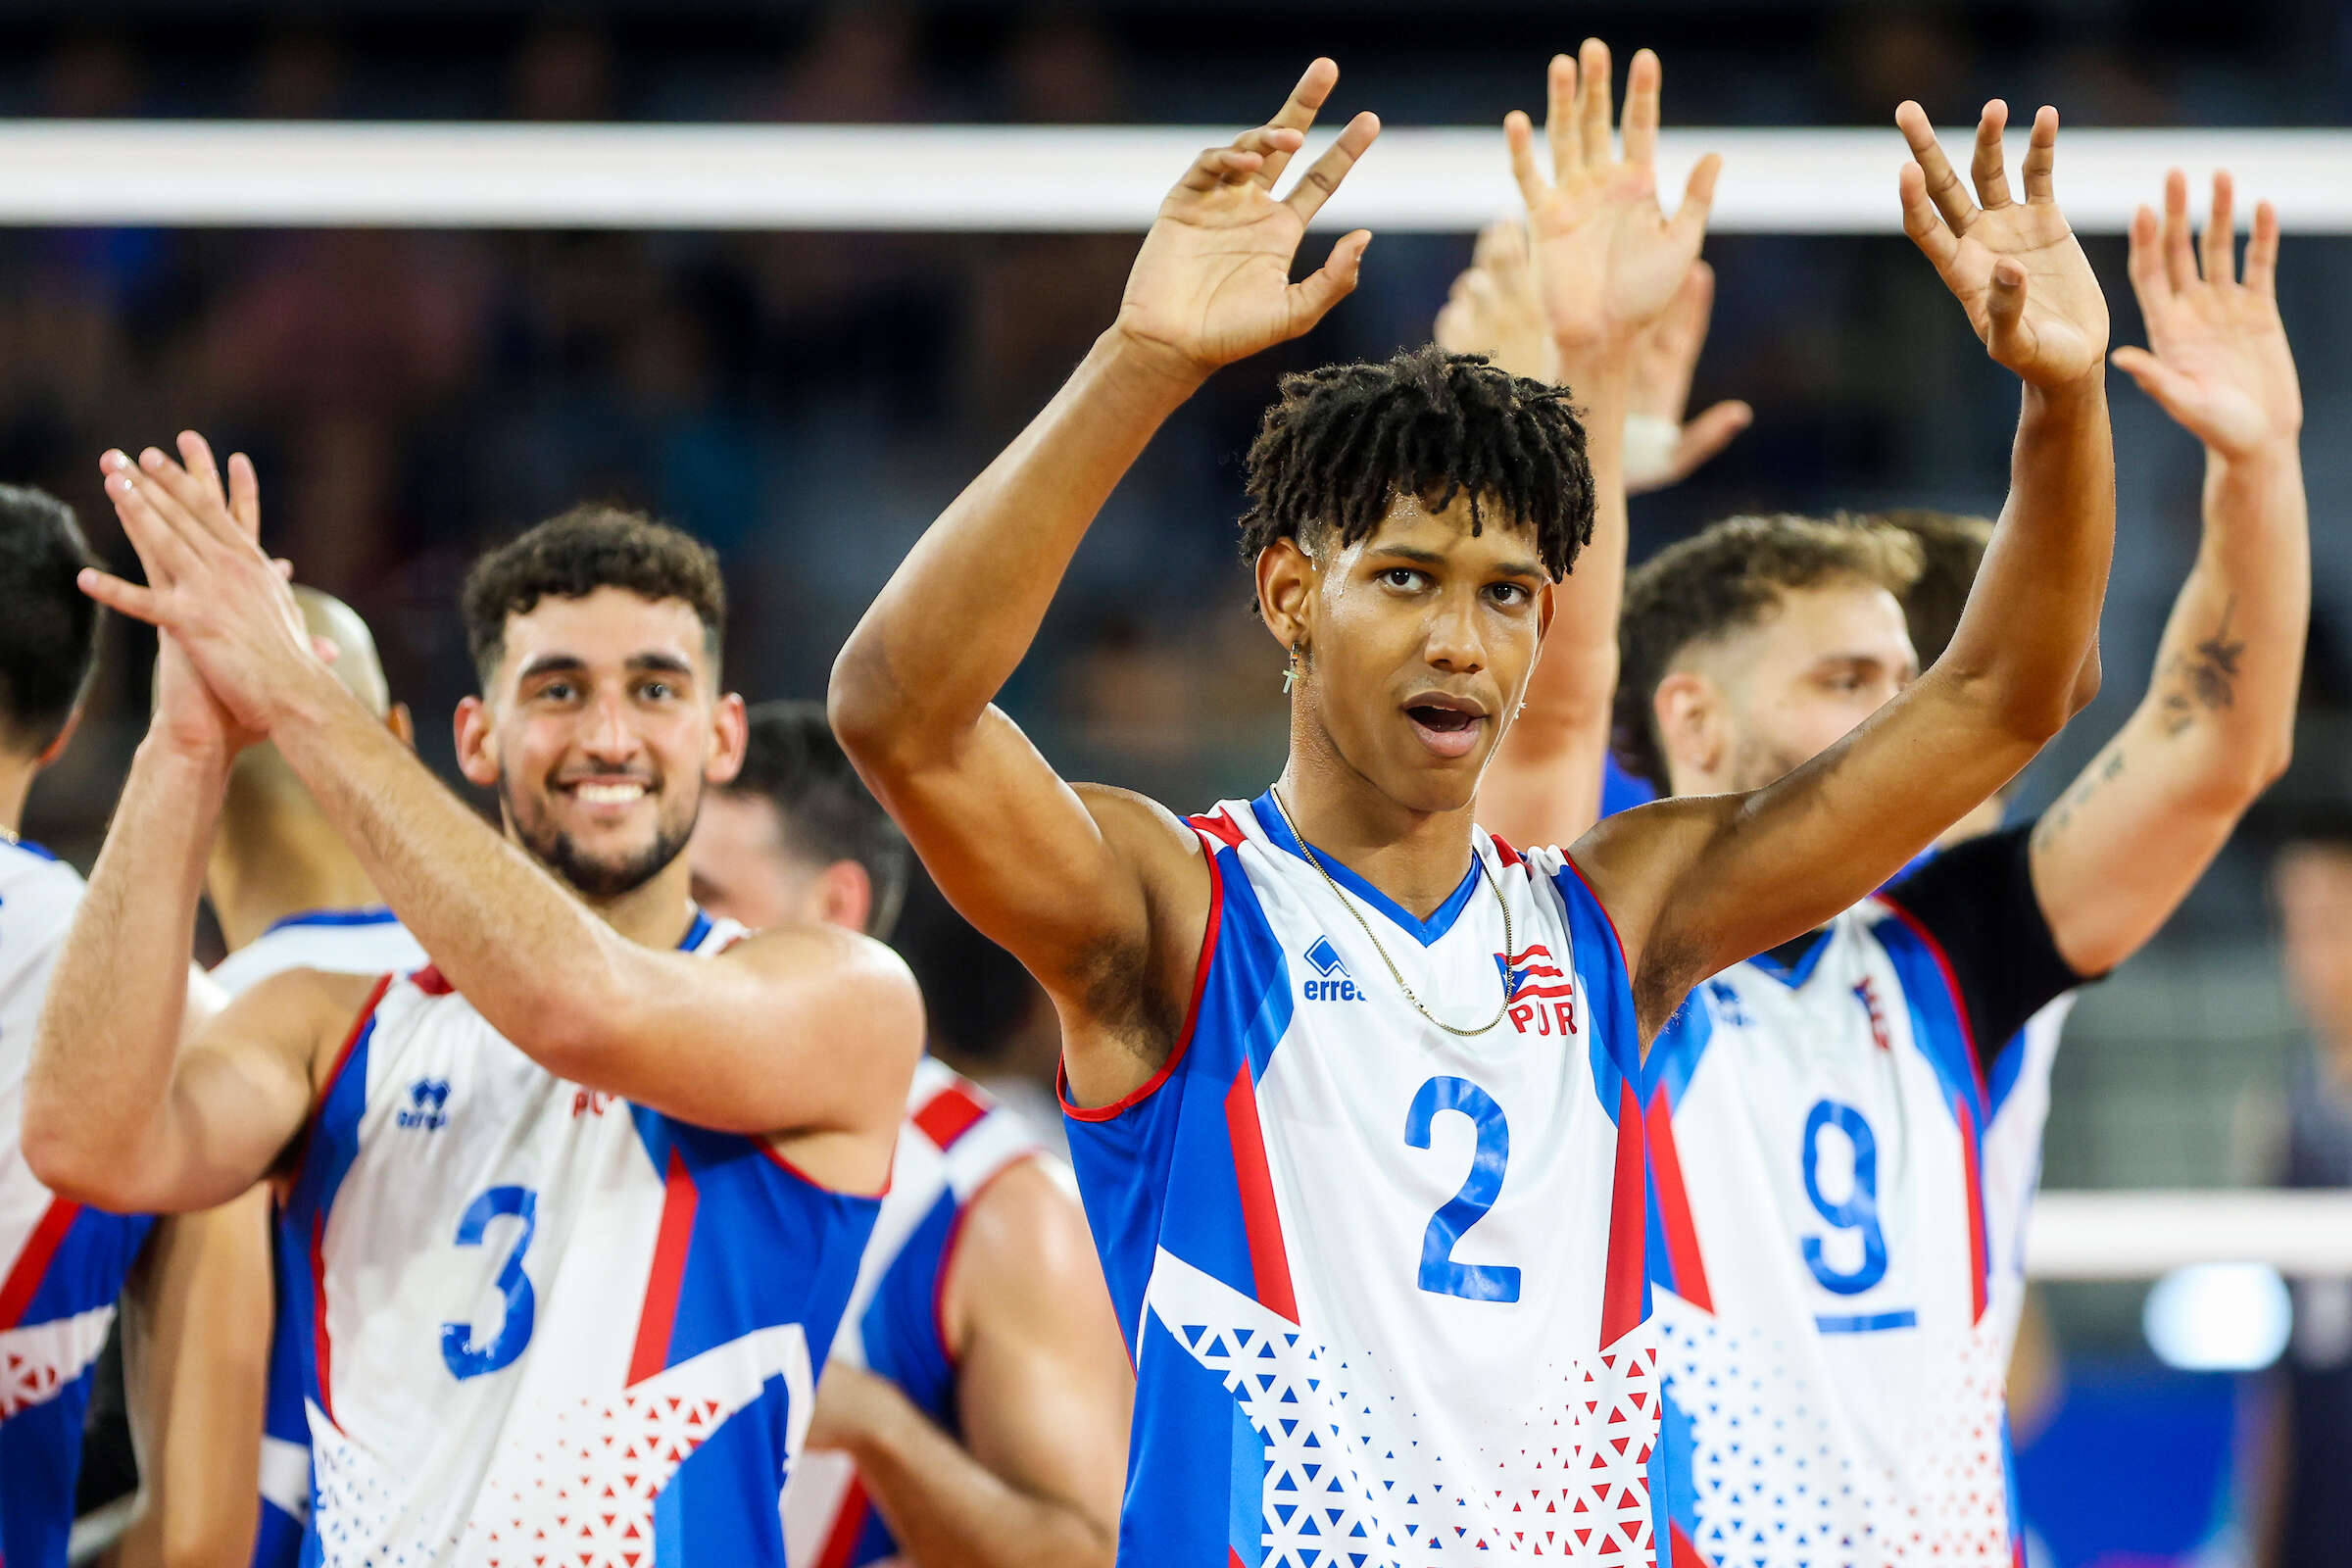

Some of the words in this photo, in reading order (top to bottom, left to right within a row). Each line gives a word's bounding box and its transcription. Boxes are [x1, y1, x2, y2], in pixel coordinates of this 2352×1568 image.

[440, 1185, 537, 1383] 3
[1404, 1076, 1521, 1302] 2
[1801, 1099, 1887, 1296] 9
